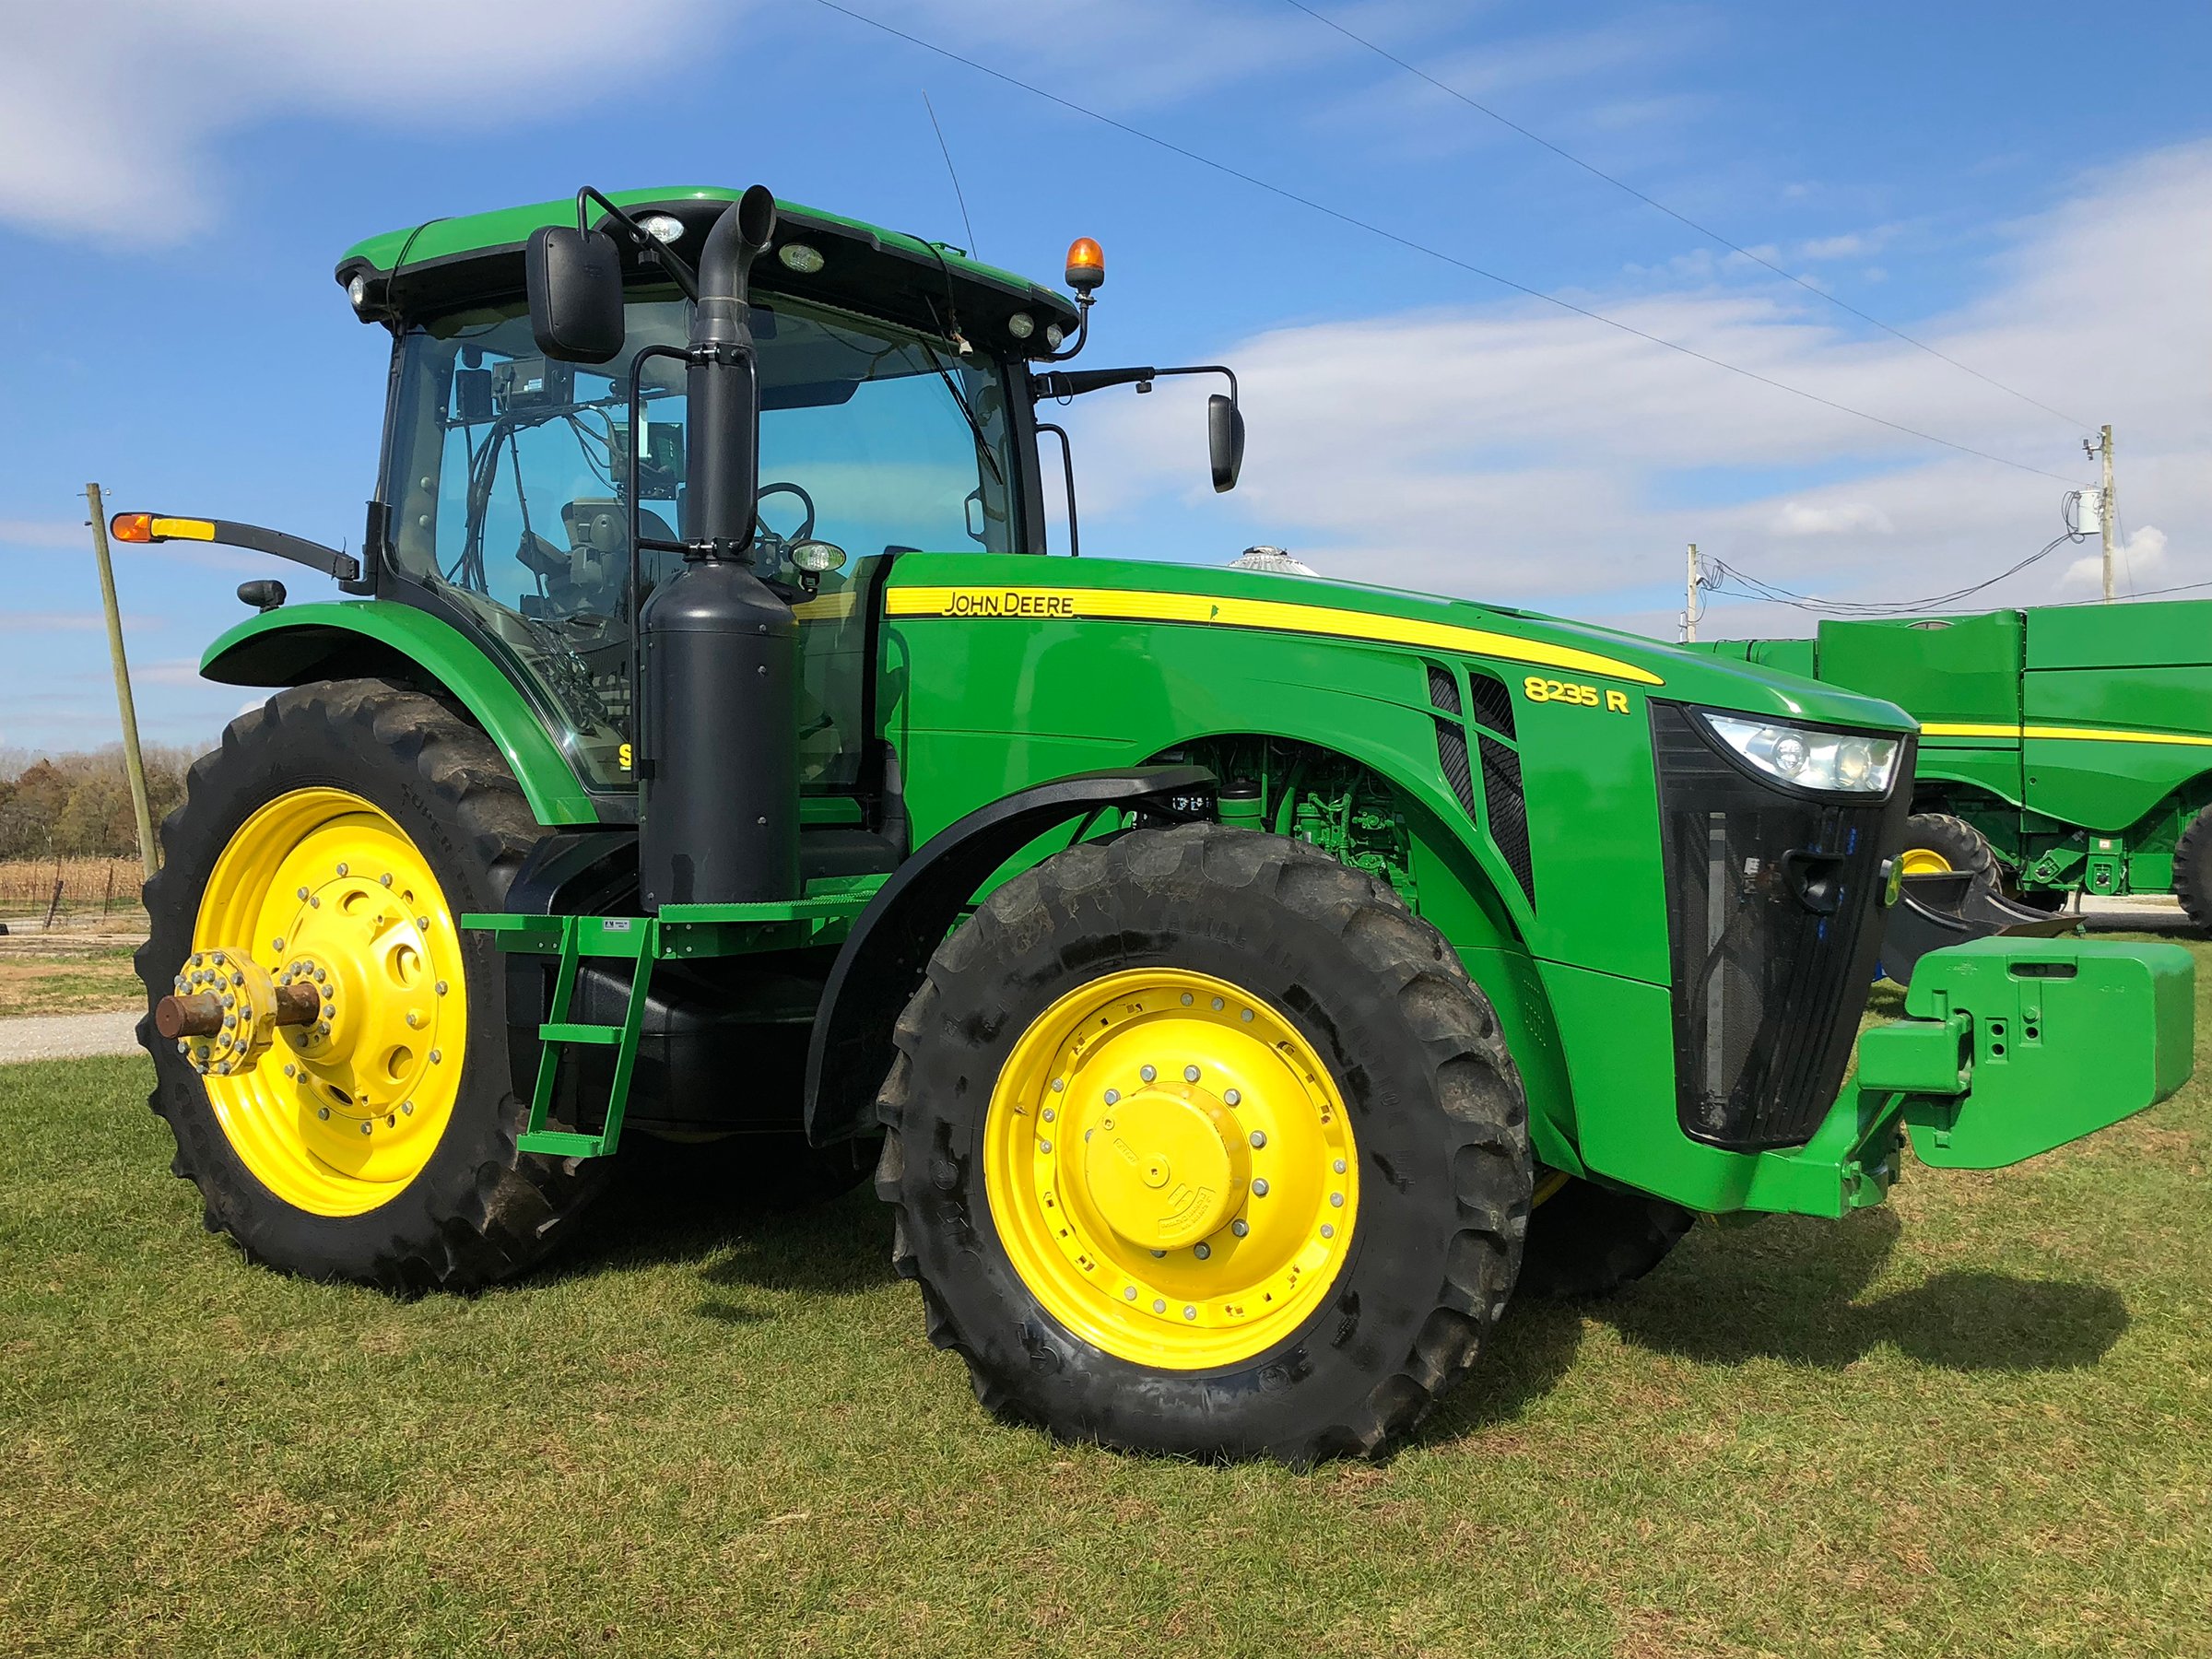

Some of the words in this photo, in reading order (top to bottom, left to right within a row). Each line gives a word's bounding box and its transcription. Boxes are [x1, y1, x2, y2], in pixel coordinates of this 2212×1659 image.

[945, 592, 998, 613] JOHN
[1005, 593, 1074, 614] DEERE
[1524, 677, 1599, 707] 8235
[1606, 689, 1630, 714] R
